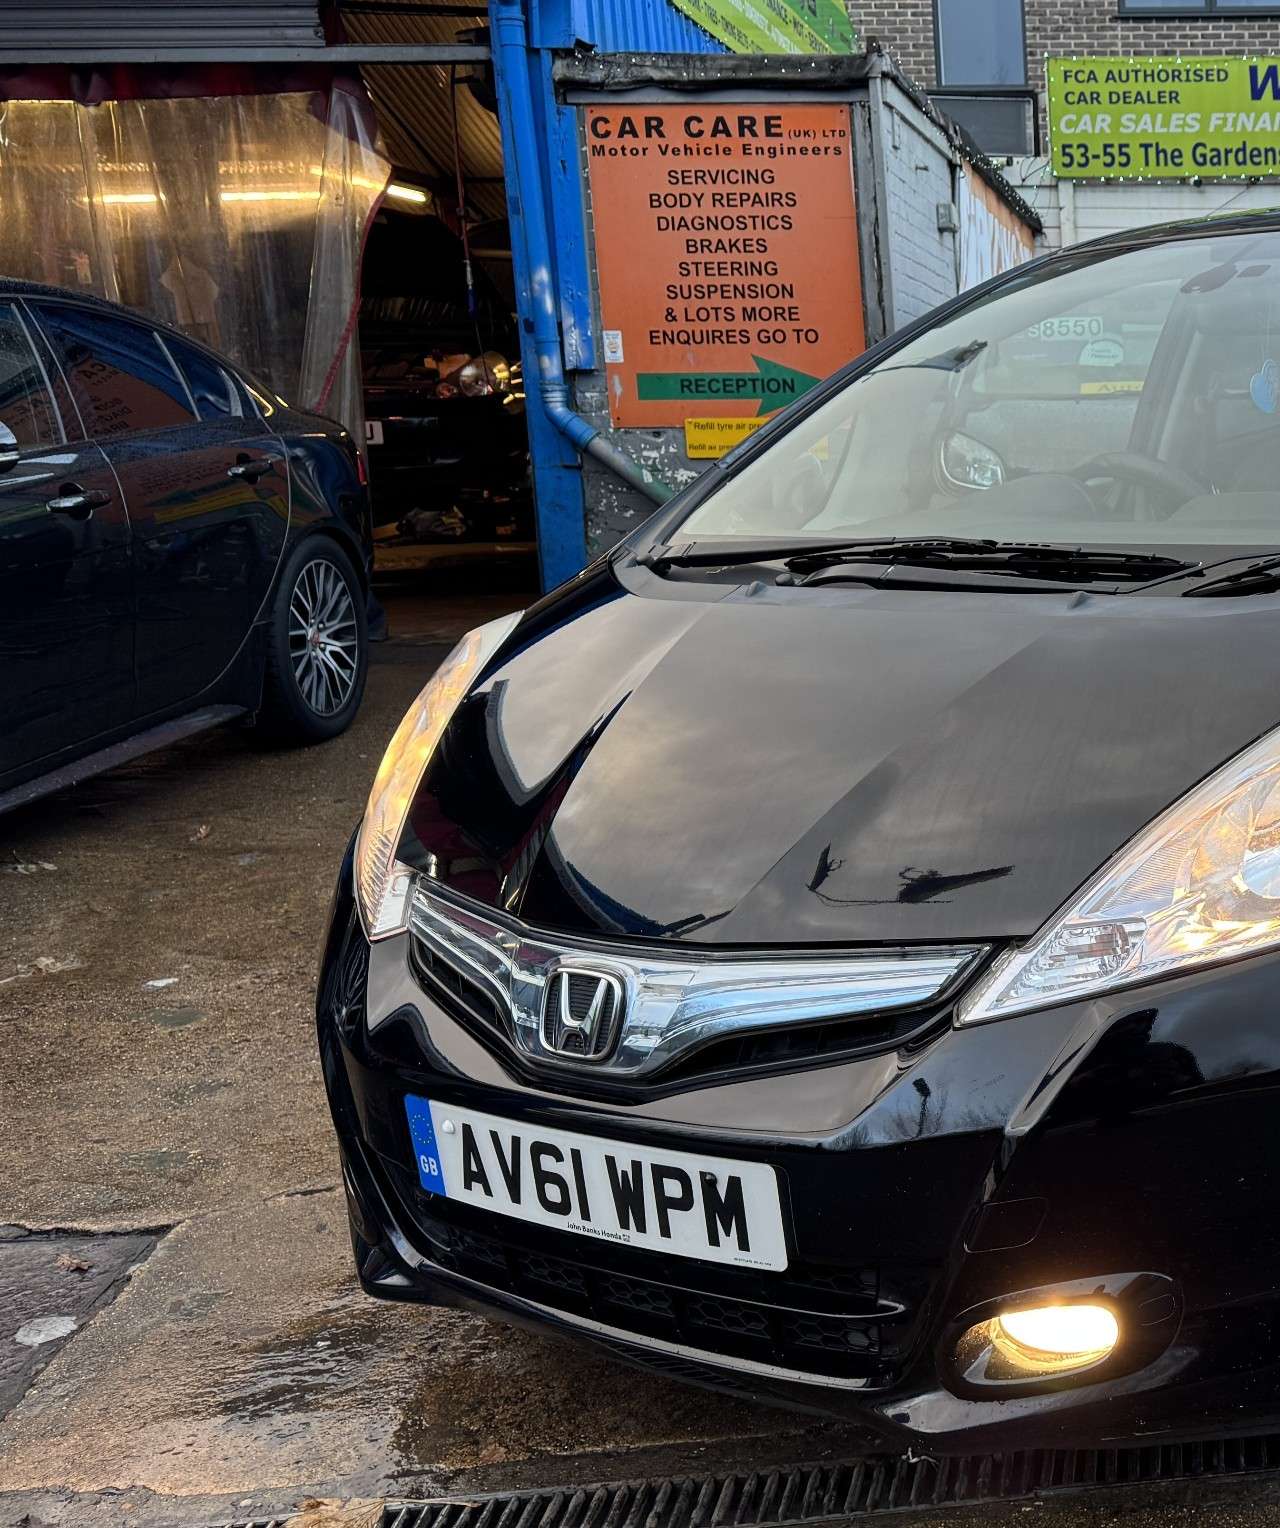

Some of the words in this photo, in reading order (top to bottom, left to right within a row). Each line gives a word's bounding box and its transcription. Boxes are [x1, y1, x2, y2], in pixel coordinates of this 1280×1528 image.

[1064, 70, 1098, 83] FCA
[1105, 69, 1228, 83] AUTHORISED
[1064, 91, 1101, 105] CAR
[1109, 91, 1180, 104] DEALER
[591, 116, 666, 139] CAR
[684, 115, 783, 138] CARE
[789, 129, 816, 139] (UK)
[1060, 114, 1111, 133] CAR
[1120, 113, 1200, 132] SALES
[592, 144, 648, 157] Motor
[658, 143, 731, 156] Vehicle
[742, 143, 842, 158] Engineers
[1062, 143, 1130, 168] 53-55
[1139, 142, 1183, 167] The
[668, 169, 774, 185] SERVICING
[649, 193, 704, 208] BODY
[712, 192, 797, 208] REPAIRS
[657, 215, 792, 231] DIAGNOSTICS
[686, 238, 767, 254] BRAKES
[679, 261, 778, 277] STEERING
[667, 284, 794, 300] SUSPENSION
[665, 307, 677, 322] &
[684, 307, 735, 322] LOTS
[742, 306, 800, 321] MORE
[649, 329, 750, 345] ENQUIRES
[757, 329, 786, 344] GO
[792, 329, 819, 343] TO
[681, 378, 794, 393] RECEPTION
[694, 422, 715, 430] Refill
[718, 422, 733, 431] tyre
[420, 1154, 439, 1177] GB
[461, 1122, 592, 1222] AV61
[604, 1154, 751, 1253] WPM
[567, 1222, 582, 1231] John
[582, 1225, 600, 1236] Banks
[601, 1229, 622, 1240] Honda
